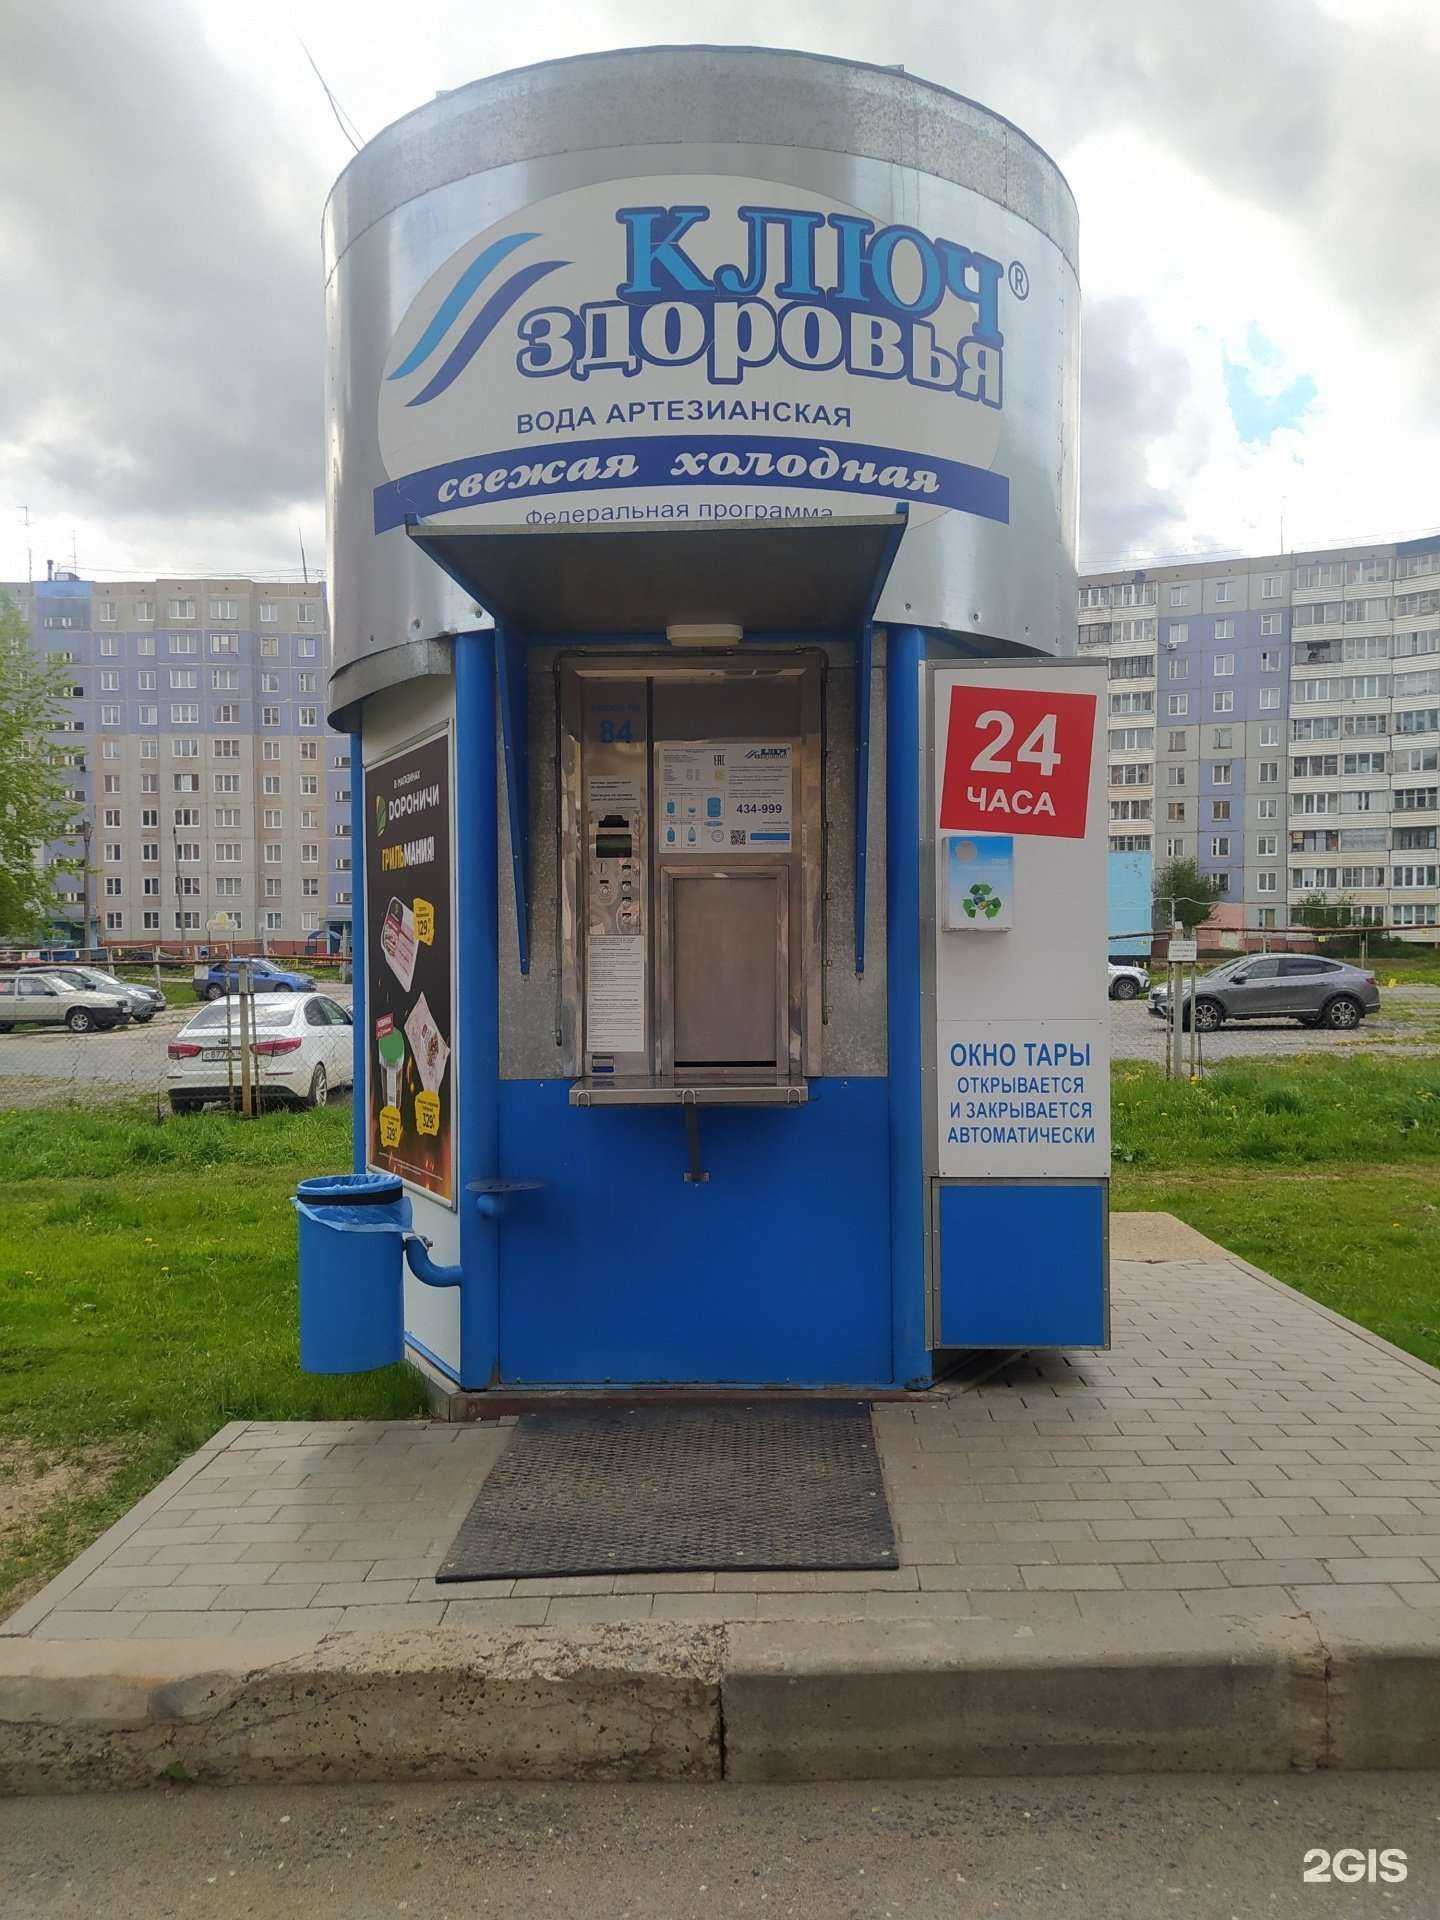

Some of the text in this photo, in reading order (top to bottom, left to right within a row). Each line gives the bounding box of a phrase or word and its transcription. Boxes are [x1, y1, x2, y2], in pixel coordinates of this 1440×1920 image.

[616, 205, 1004, 341] КЛЮЧ
[517, 400, 852, 434] ВОДА АРТЕЗИАНСКАЯ
[437, 446, 940, 502] свежая холодная
[526, 502, 833, 525] Федеральная программа
[601, 719, 633, 743] 84
[970, 710, 1061, 776] 24
[736, 803, 783, 814] 434-999
[967, 786, 1057, 816] ЧАСА
[950, 1043, 1091, 1067] ОКНО ТАРЫ
[957, 1077, 1084, 1094] ОТКРЫВАЕТСЯ
[950, 1102, 1092, 1119] И ЗАКРЫВАЕТСЯ
[948, 1126, 1095, 1144] АВТОМАТИЧЕСКИ
